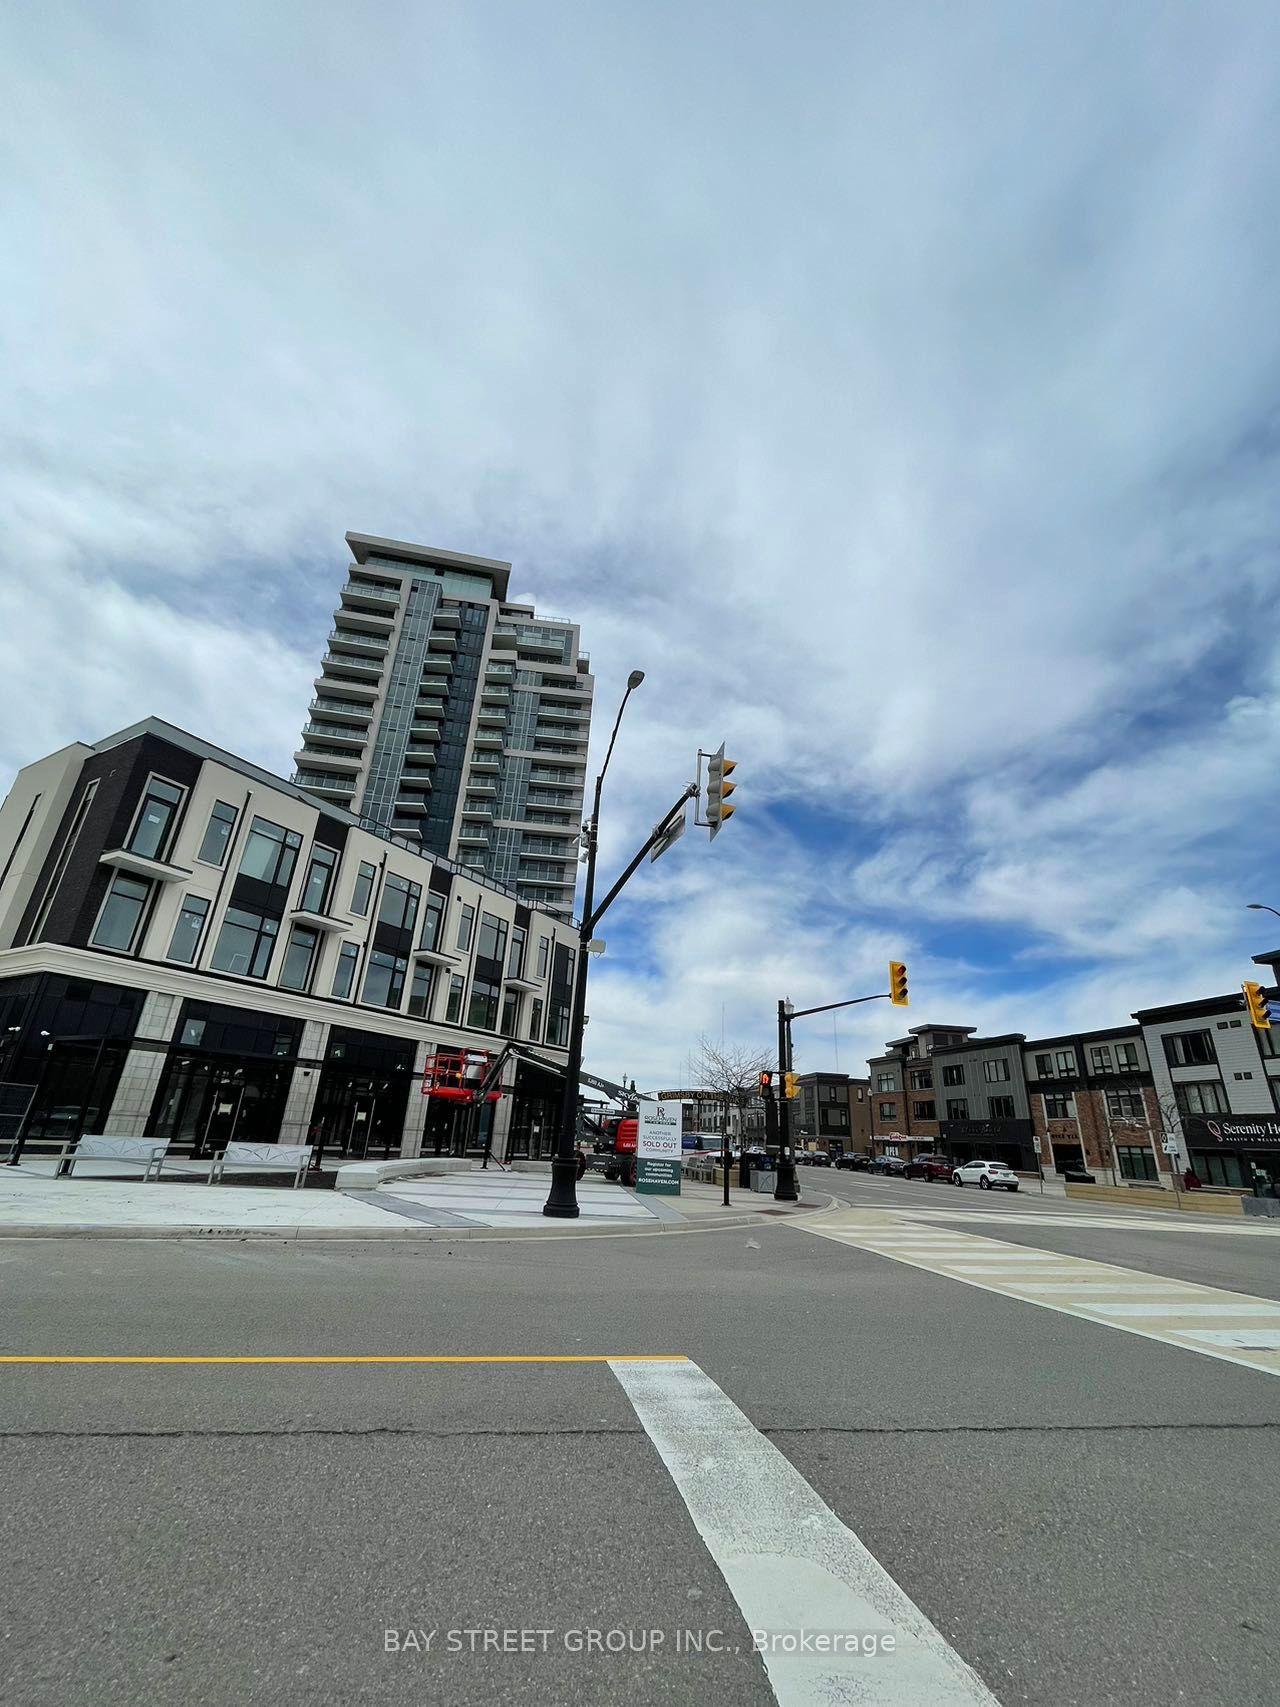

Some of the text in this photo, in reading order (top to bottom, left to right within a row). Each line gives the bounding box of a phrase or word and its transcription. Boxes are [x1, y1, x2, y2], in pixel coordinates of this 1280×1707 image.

[660, 1091, 694, 1100] GRIMSBY
[696, 1091, 708, 1099] ON
[1222, 1122, 1266, 1137] Serenity
[642, 1140, 661, 1148] SOLD
[662, 1141, 677, 1149] OUT
